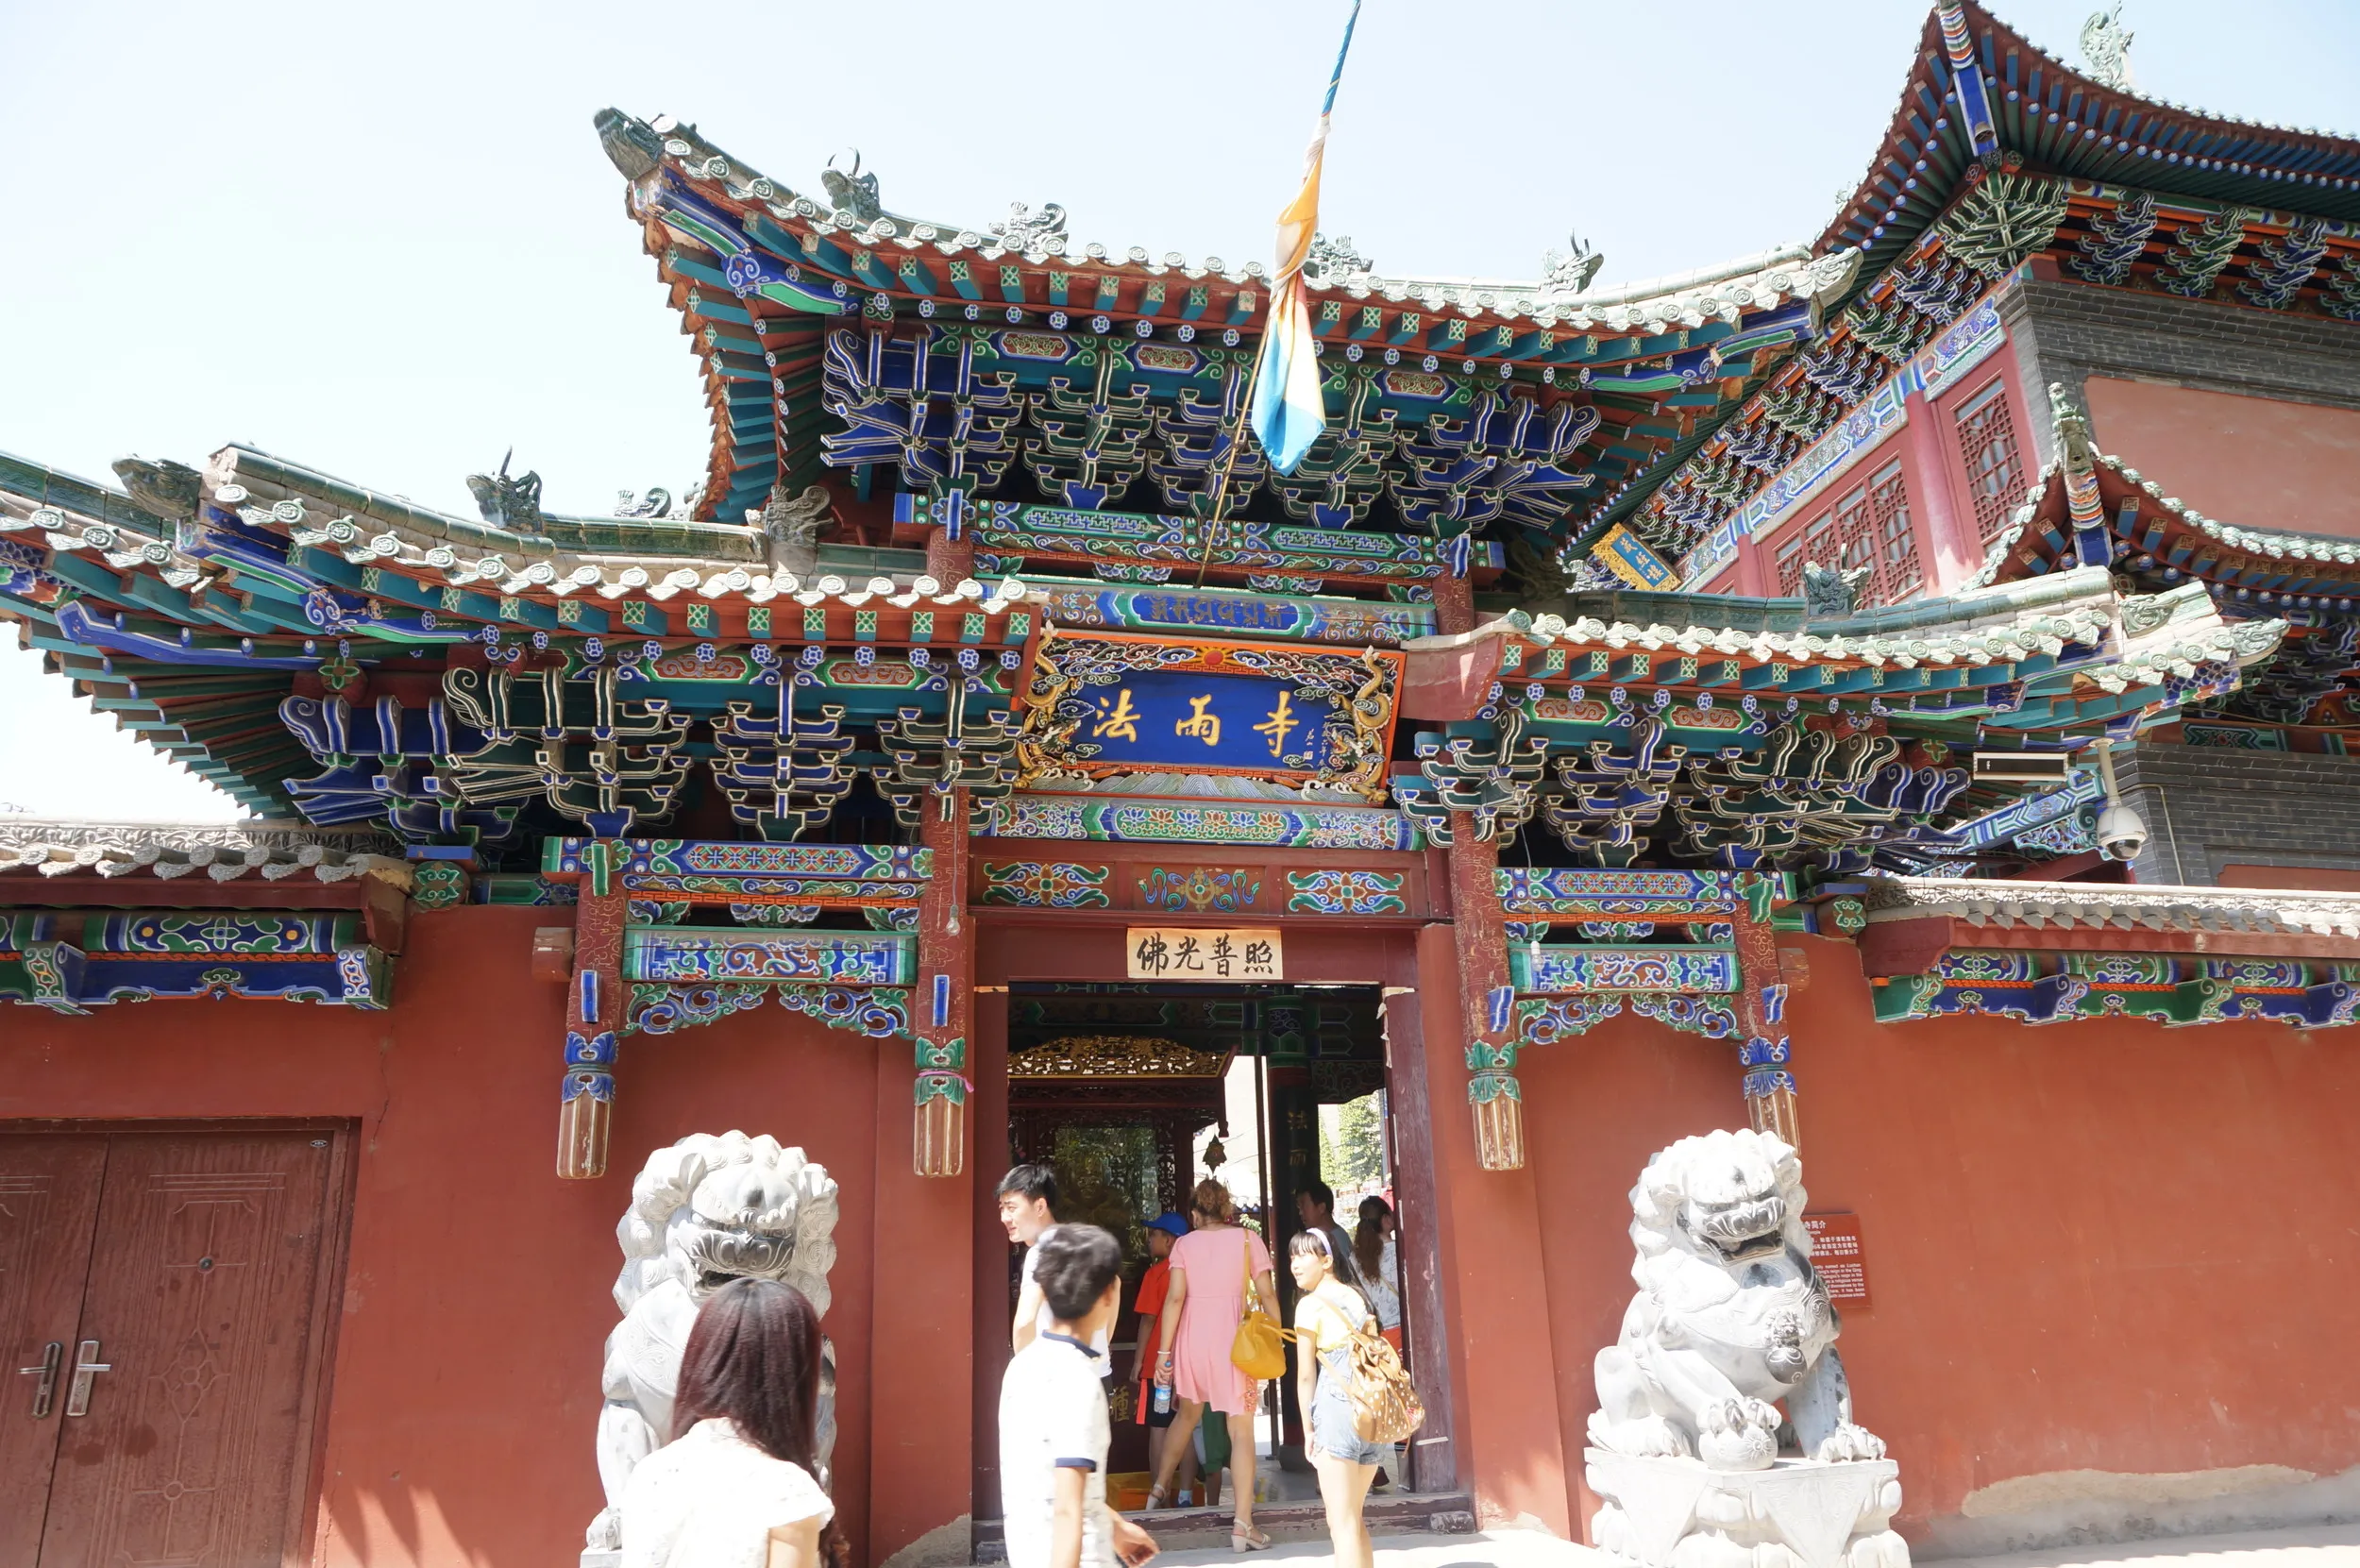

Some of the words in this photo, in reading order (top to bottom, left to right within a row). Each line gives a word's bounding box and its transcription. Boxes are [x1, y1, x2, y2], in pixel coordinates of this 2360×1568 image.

[1092, 688, 1299, 757] 法雨寺
[1137, 931, 1273, 977] 佛光普照
